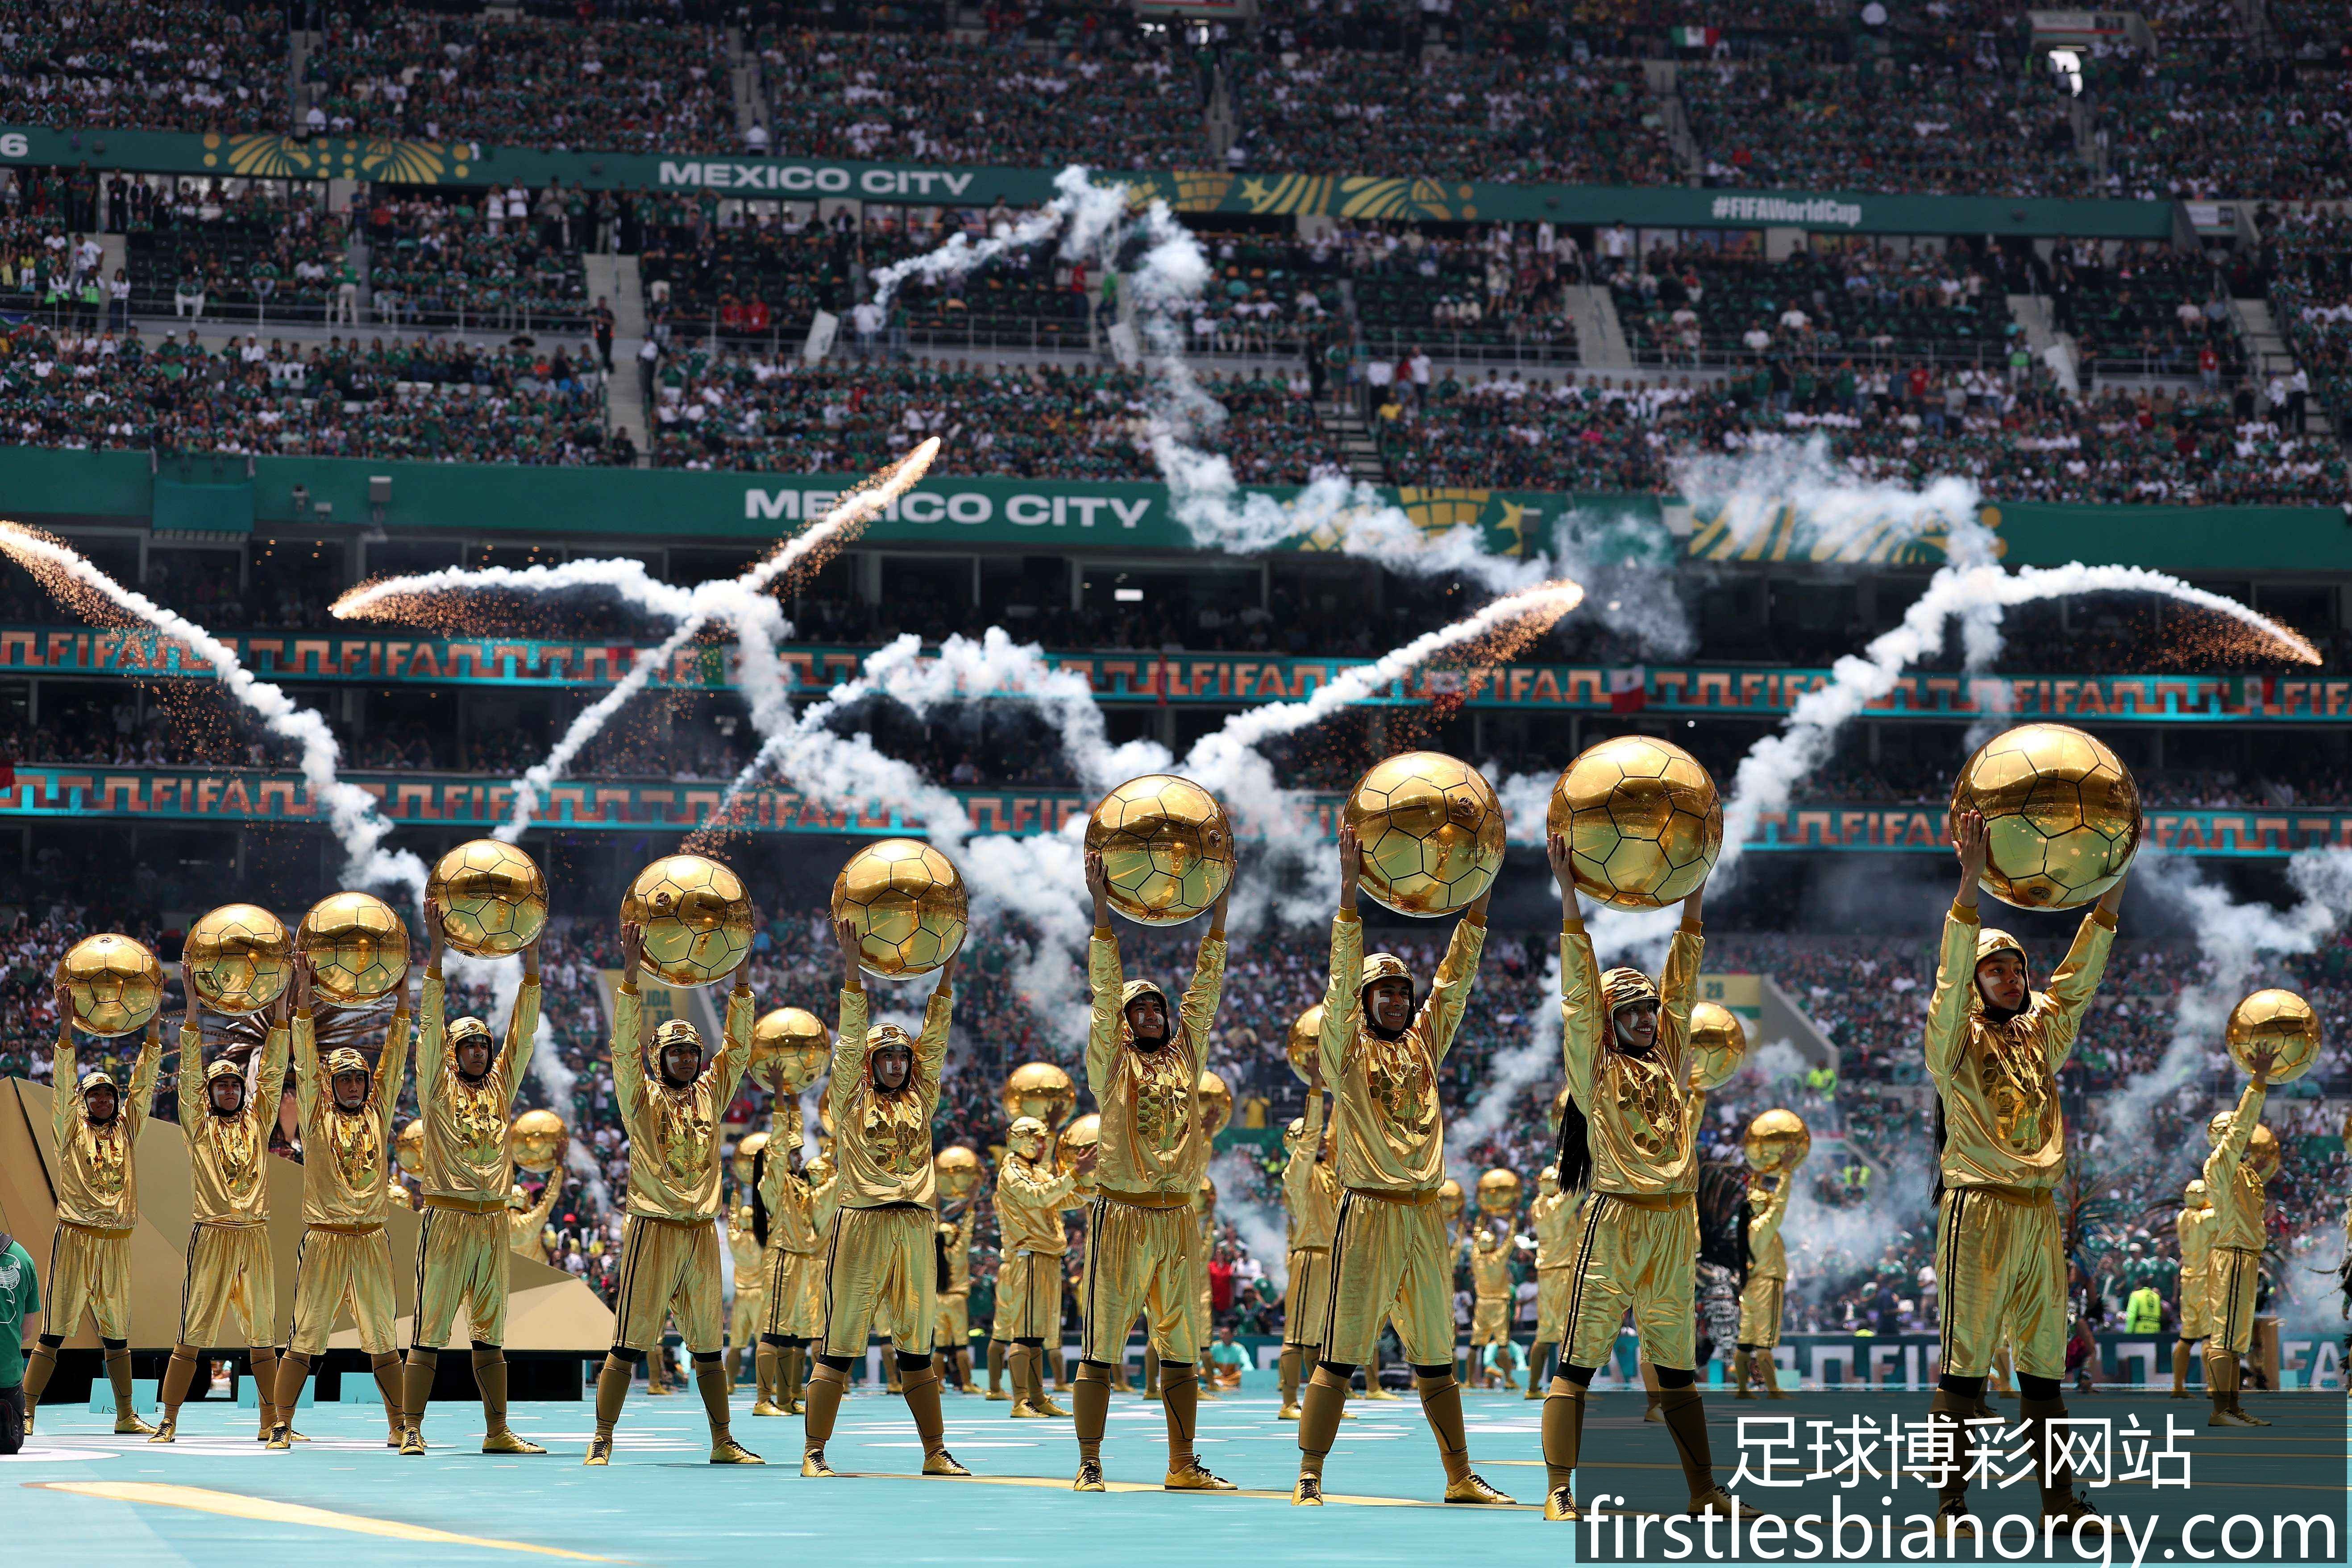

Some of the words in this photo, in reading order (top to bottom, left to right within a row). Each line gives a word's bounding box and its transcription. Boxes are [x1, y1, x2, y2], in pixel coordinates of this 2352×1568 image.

[0, 133, 28, 157] 6
[660, 161, 850, 193] MEXICO
[860, 169, 974, 195] CITY
[1712, 195, 1861, 228] #FIFAWorldCup
[745, 489, 993, 524] MEICO
[1005, 495, 1151, 528] CITY
[49, 632, 149, 668] FIFA
[341, 641, 440, 677] FIFA
[1192, 663, 1287, 696] FIFA
[1467, 668, 1562, 702] FIFA
[2013, 680, 2107, 713] FIFA
[2284, 682, 2352, 715] FIF
[152, 778, 252, 812] FIFA
[731, 792, 828, 828] FIFA
[1013, 798, 1096, 832] FIF
[1842, 812, 1935, 845] FIFA
[2142, 816, 2206, 850] IFA
[640, 989, 671, 1007] LIDA
[2282, 1340, 2349, 1390] FA
